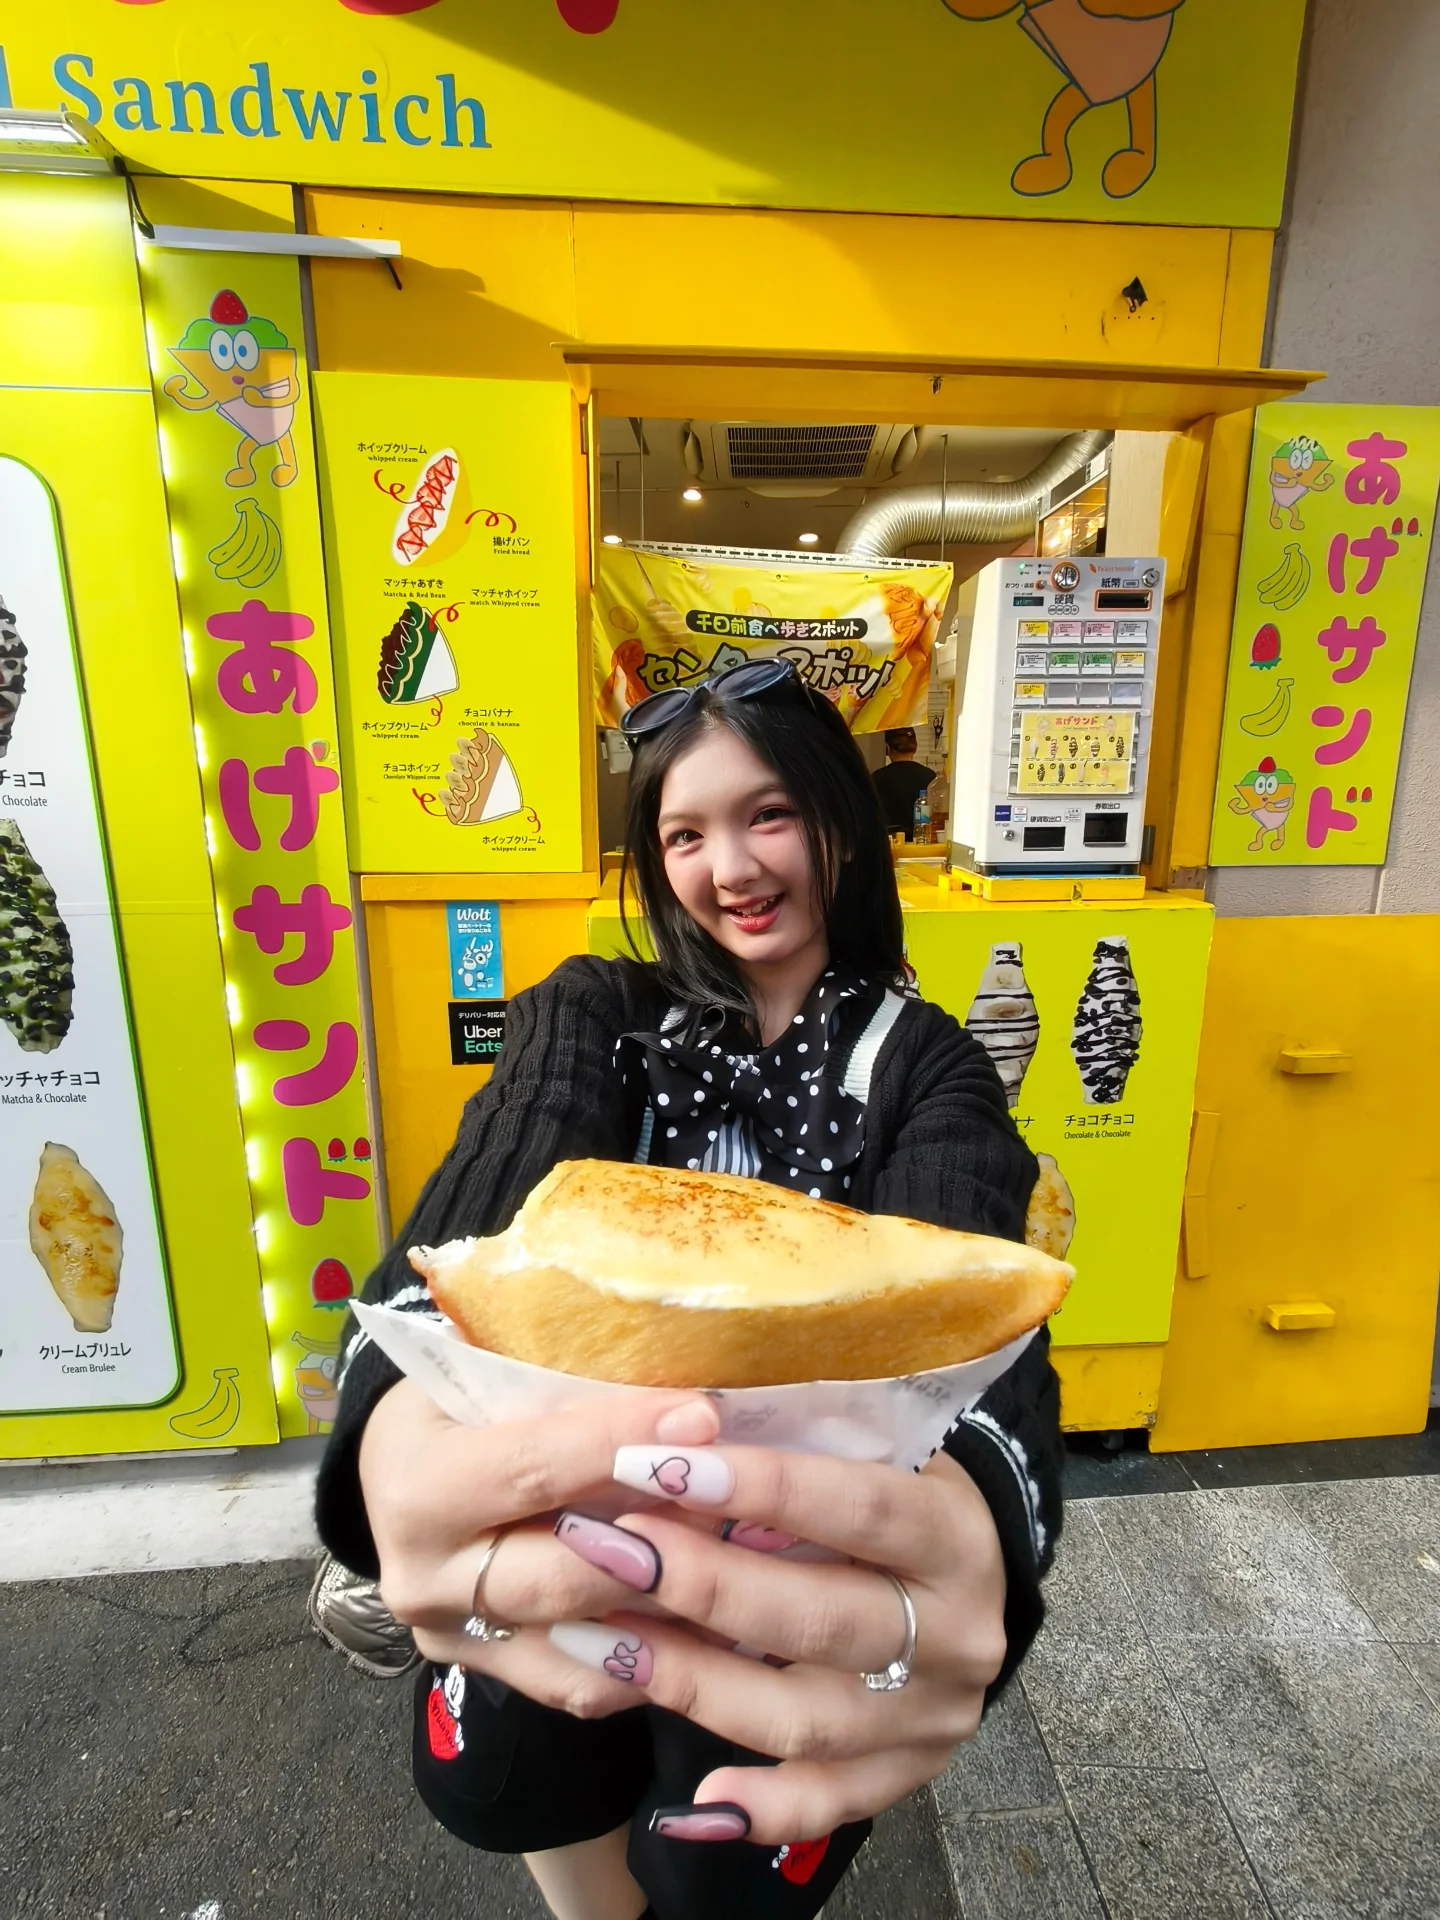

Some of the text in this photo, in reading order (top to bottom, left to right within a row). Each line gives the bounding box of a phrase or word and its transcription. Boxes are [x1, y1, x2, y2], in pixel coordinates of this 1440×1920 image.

[53, 53, 492, 149] Sandwich
[357, 442, 428, 454] ホイップクリーム
[384, 579, 444, 589] マッチャあずき
[1101, 578, 1121, 588] 紙幣
[472, 589, 538, 598] マッチャホイップ
[1054, 594, 1074, 604] 硬貨
[696, 613, 860, 638] 千日前食べ歩きスポット
[1305, 431, 1420, 849] あげサンド
[464, 708, 513, 718] チョコバナナ
[362, 722, 428, 731] ホイップクリーム
[383, 763, 440, 773] チョコホイップ
[2, 794, 48, 807] Chocolate
[482, 836, 545, 845] ホイップクリーム
[457, 908, 492, 921] Wolt
[458, 1011, 506, 1019] デリバリー対応店
[464, 1025, 503, 1039] Uber
[465, 1040, 504, 1054] Eats
[1, 1092, 87, 1104] Matcha & Chocolate
[1064, 1113, 1135, 1127] チョコチョコ
[1064, 1131, 1094, 1140] Chocolate
[1101, 1130, 1131, 1138] Chocolate
[39, 1342, 132, 1360] クリームブリュレ
[61, 1363, 116, 1374] Cream Brulee
